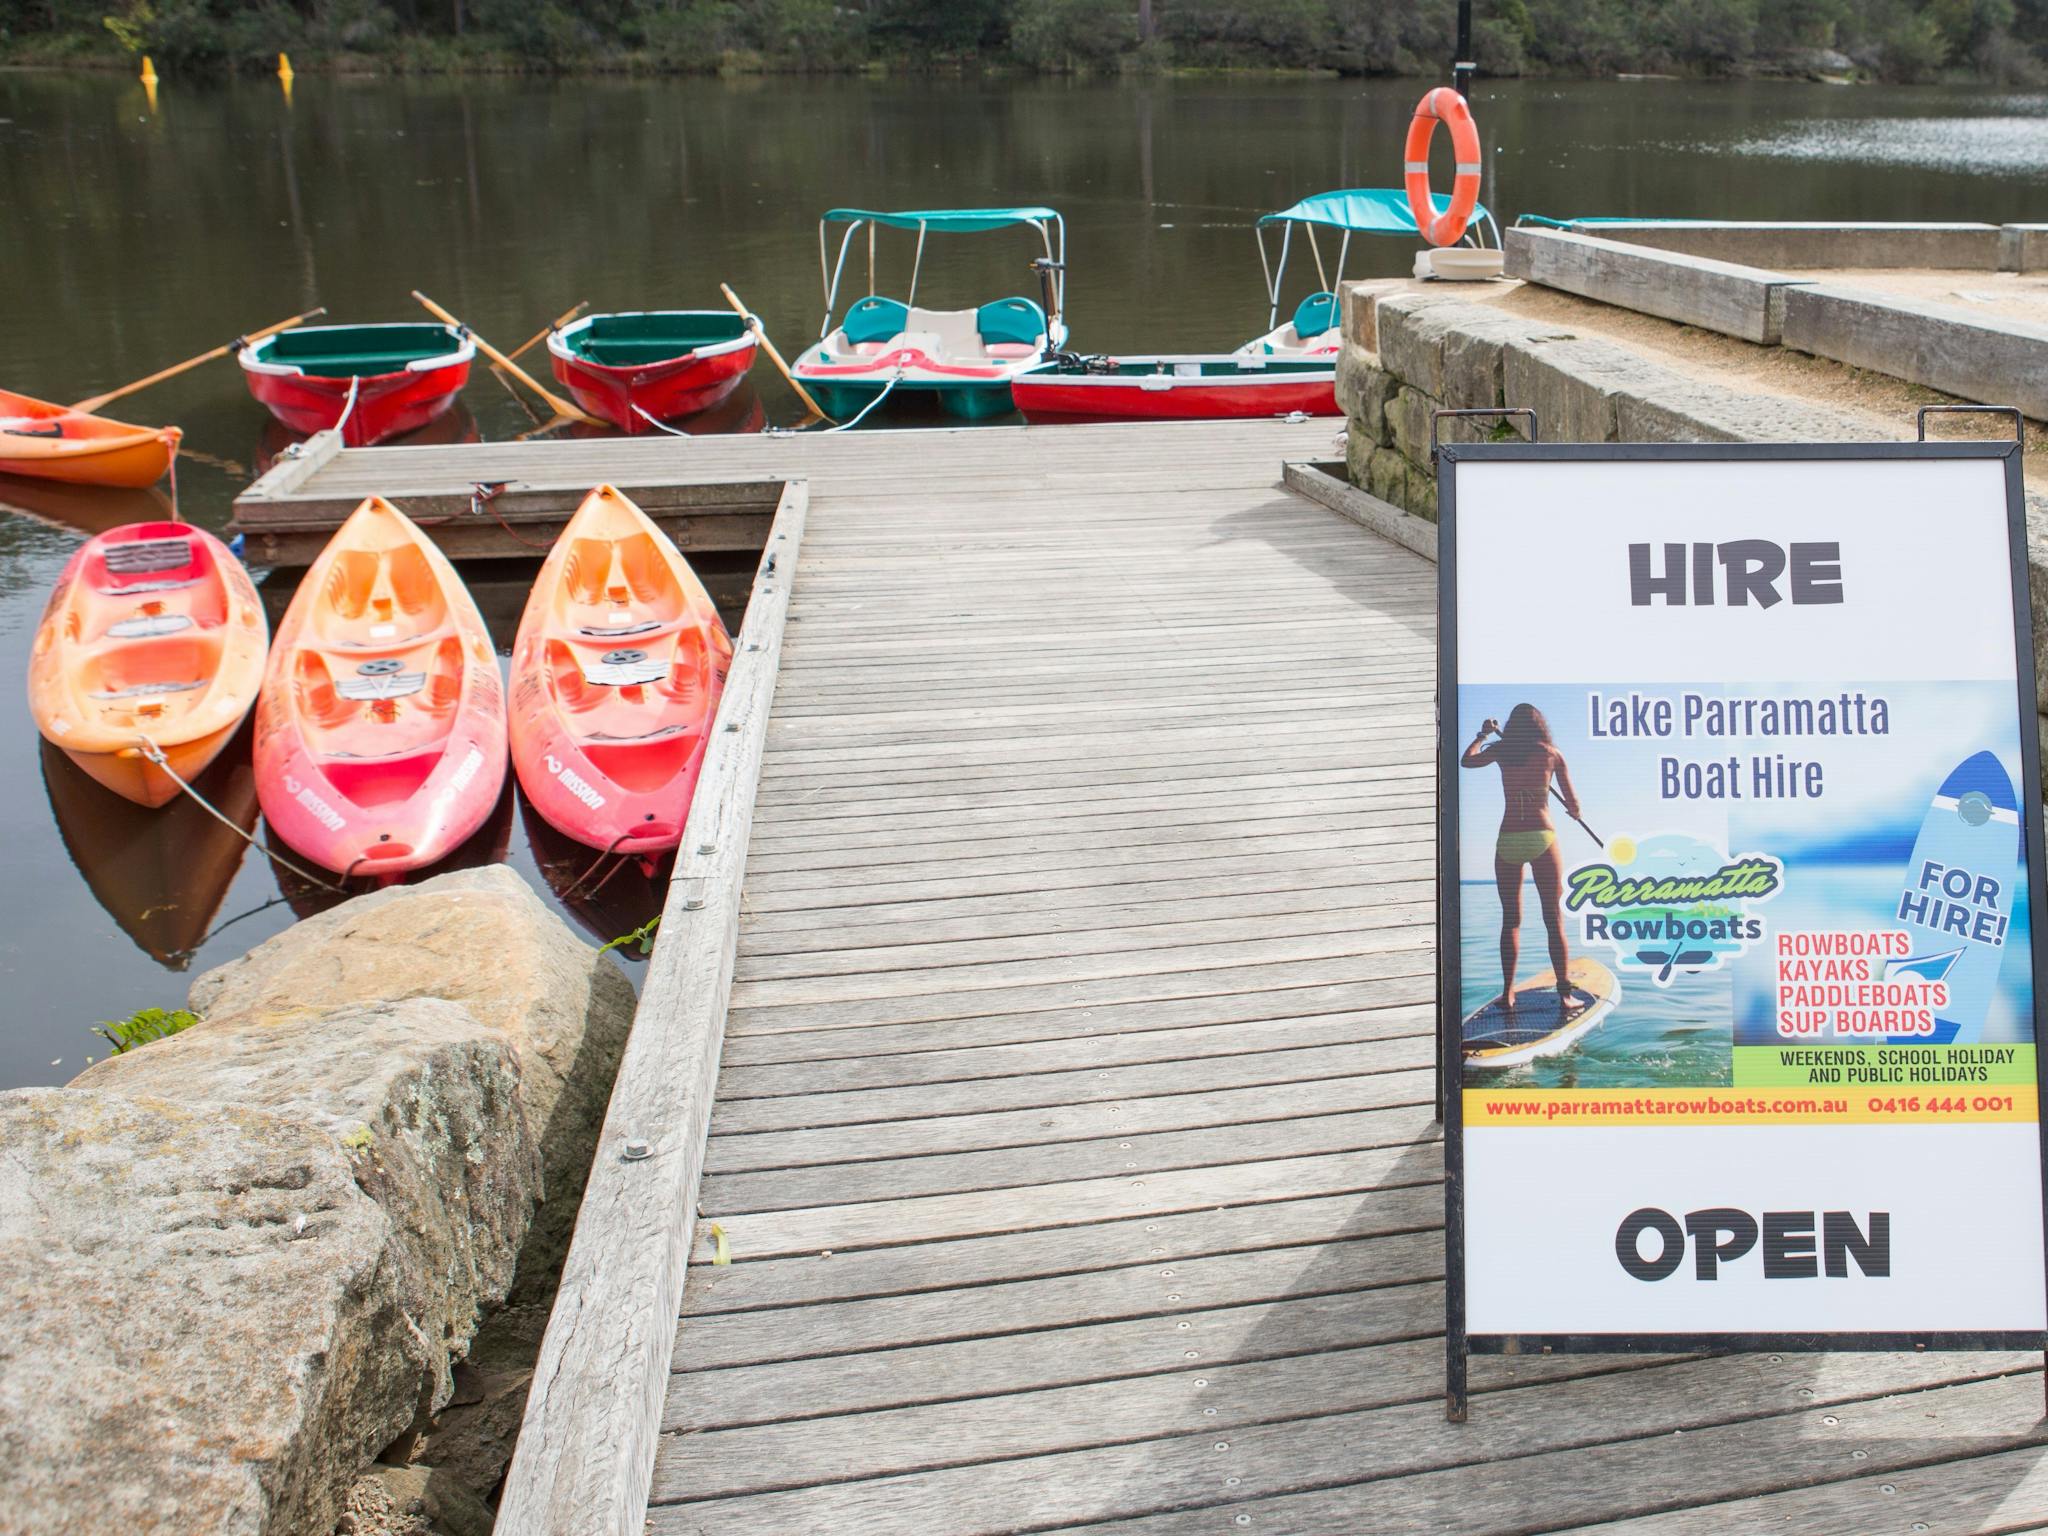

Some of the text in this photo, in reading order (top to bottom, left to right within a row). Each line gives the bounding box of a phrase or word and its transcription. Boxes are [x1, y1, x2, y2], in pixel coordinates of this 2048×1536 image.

[1628, 539, 1844, 610] HIRE
[1591, 693, 1890, 737] Lake Parramatta
[1661, 754, 1824, 799] Boat Hire
[1568, 860, 1777, 909] Parramatta
[1919, 861, 2001, 909] FOR
[1586, 913, 1761, 941] Rowboats
[1898, 891, 2008, 946] HIRE!
[1778, 933, 1910, 957] ROWBOATS
[1779, 959, 1869, 982] KAYAKS
[1780, 984, 1947, 1007] PADDLEBOATS
[1780, 1010, 1932, 1034] SUP BOARDS
[1780, 1049, 2015, 1067] WEEKENDS, SCHOOL HOLIDAY
[1808, 1066, 1988, 1083] AND PUBLIC HOLIDAYS
[1486, 1097, 1848, 1120] www.parramattarowboats.com.au
[1868, 1096, 2013, 1113] 0416 444 001
[1615, 1207, 1890, 1282] OPEN
